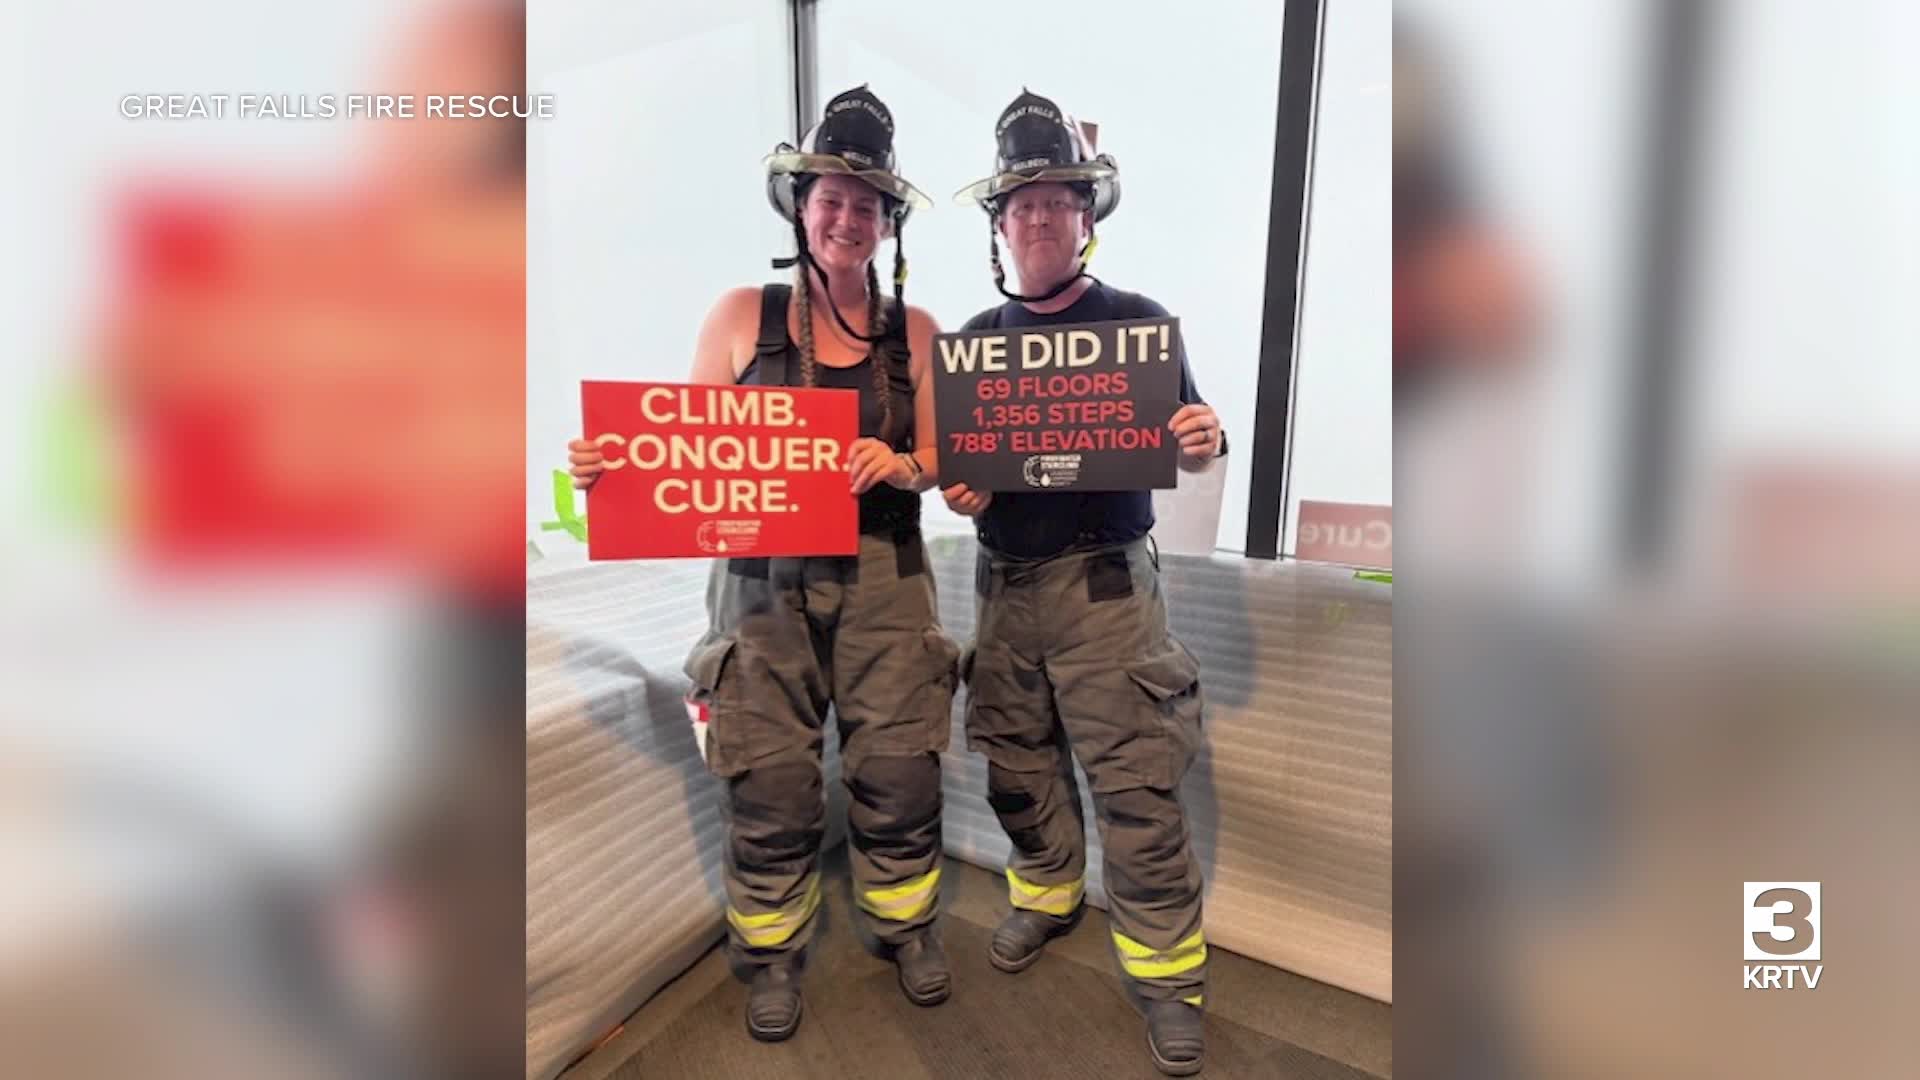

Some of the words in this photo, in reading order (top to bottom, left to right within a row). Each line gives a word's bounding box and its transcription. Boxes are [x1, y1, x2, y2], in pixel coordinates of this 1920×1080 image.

[863, 102, 889, 124] FALLS
[1028, 105, 1054, 119] FALLS
[939, 336, 1007, 373] WE
[1022, 330, 1101, 369] DID
[1117, 325, 1170, 364] IT!
[977, 378, 1011, 400] 69
[1018, 372, 1129, 398] FLOORS
[640, 387, 807, 427] CLIMB.
[972, 404, 1041, 429] 1,356
[1048, 400, 1135, 424] STEPS
[595, 433, 850, 472] CONQUER.
[950, 432, 1003, 454] 788'
[1011, 427, 1161, 452] ELEVATION
[654, 478, 799, 513] CURE.
